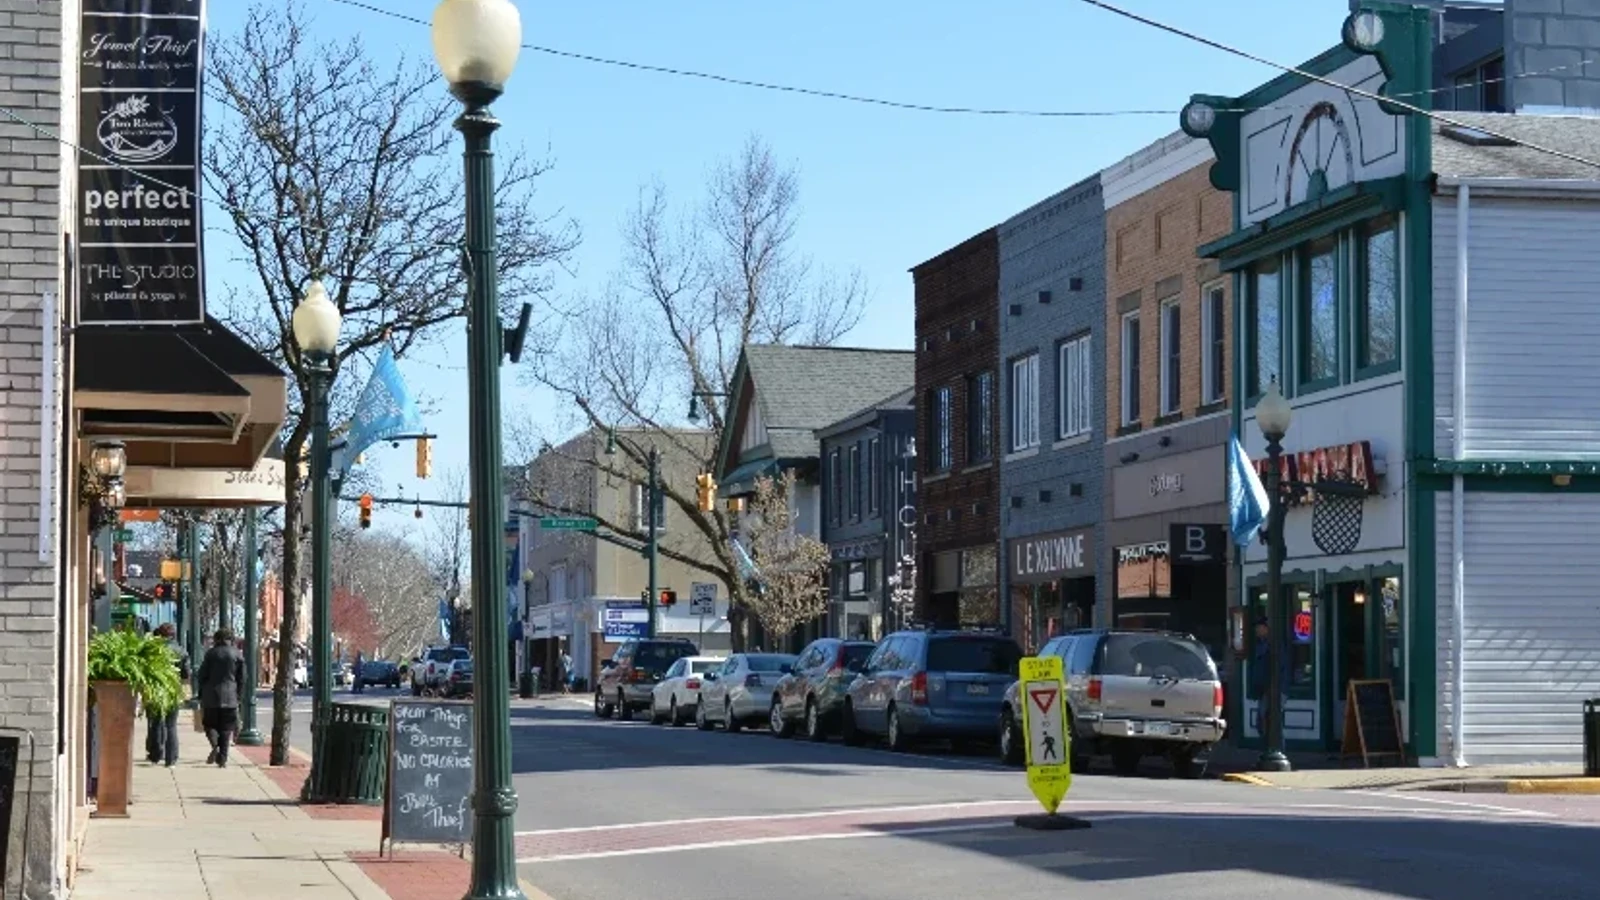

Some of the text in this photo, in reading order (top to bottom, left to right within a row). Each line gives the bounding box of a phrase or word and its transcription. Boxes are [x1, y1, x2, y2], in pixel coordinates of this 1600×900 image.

[145, 34, 197, 55] Thief
[85, 184, 191, 215] perfect
[84, 217, 191, 228] the unique boutique
[122, 264, 196, 289] STUDIO
[150, 292, 176, 302] yoga
[1186, 526, 1206, 551] B
